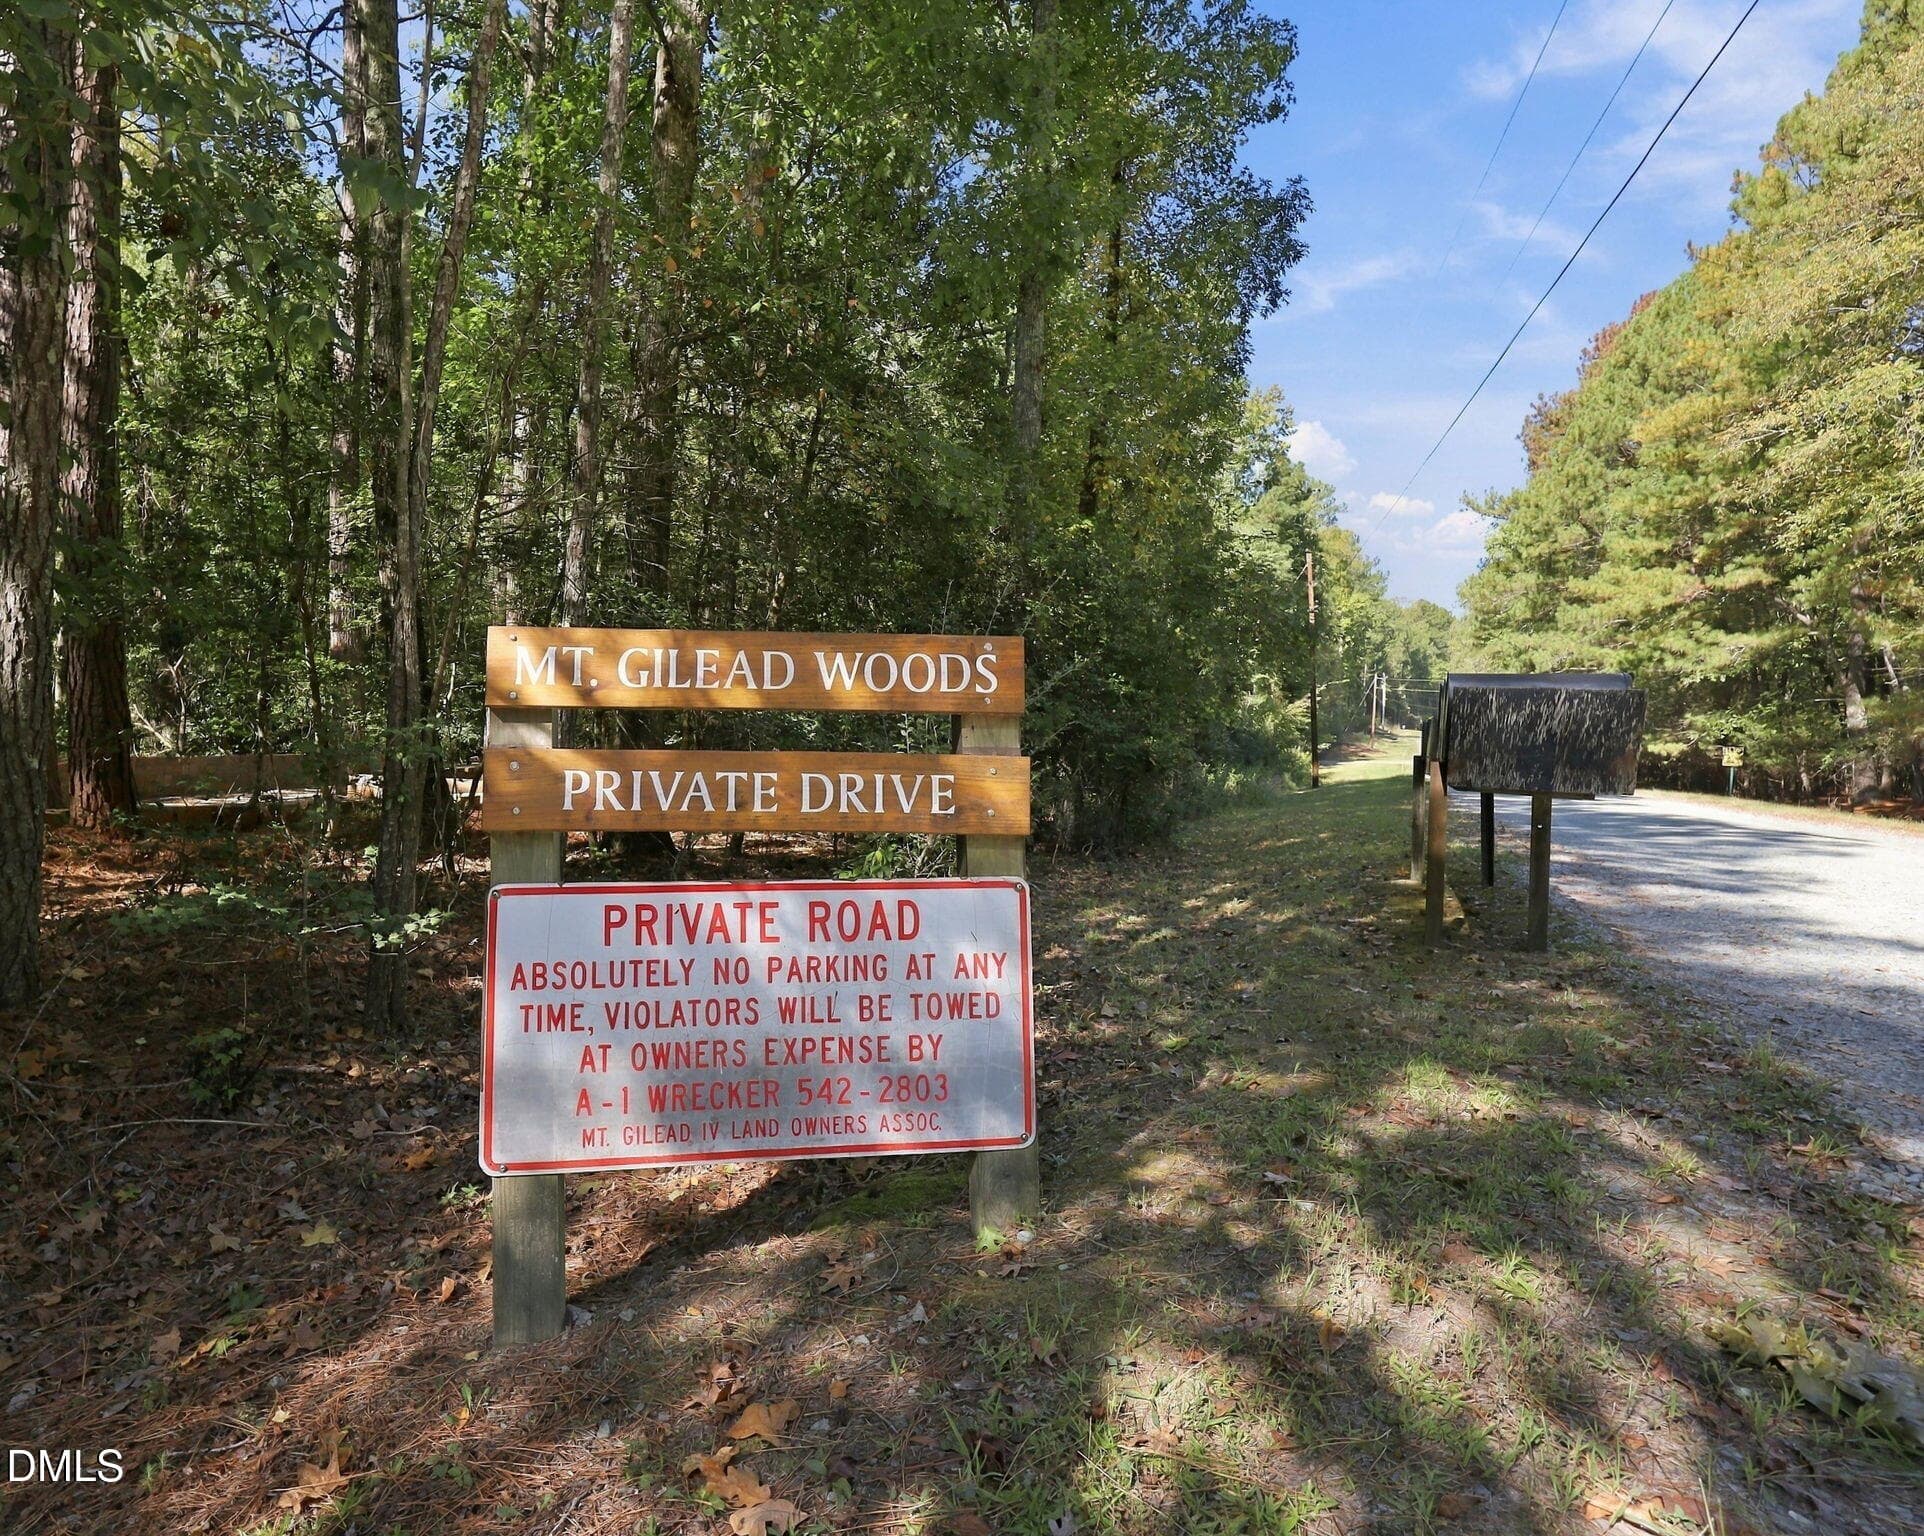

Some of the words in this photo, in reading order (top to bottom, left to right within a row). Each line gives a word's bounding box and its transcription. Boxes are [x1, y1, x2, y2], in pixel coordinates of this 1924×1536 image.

[514, 645, 599, 687] MT.
[617, 647, 796, 691] GILEAD
[814, 651, 998, 694] WOODS
[562, 770, 779, 812] PRIVATE
[800, 773, 956, 815] DRIVE
[604, 901, 780, 946] PRIVATE
[808, 899, 920, 943] ROAD
[511, 957, 696, 991] ABSOLUTELY
[714, 957, 749, 984] NO
[767, 954, 887, 983] PARKING
[906, 953, 936, 981] AT
[954, 952, 1008, 979] ANY
[519, 1003, 594, 1035] TIME,
[605, 997, 760, 1030] VIOLATORS
[778, 995, 841, 1025] WILL
[858, 994, 892, 1021] BE
[911, 992, 1001, 1020] TOWED
[580, 1044, 612, 1073] AT
[631, 1040, 746, 1071] OWNERS
[765, 1035, 890, 1066] EXPENSE
[908, 1034, 944, 1062] BY
[648, 1080, 780, 1112] WRECKER
[581, 1127, 609, 1148] MT.
[623, 1122, 691, 1146] GILEAD
[702, 1121, 719, 1141] IV
[732, 1117, 779, 1139] LAND
[791, 1115, 867, 1136] OWNERS
[880, 1112, 942, 1133] ASSOC.
